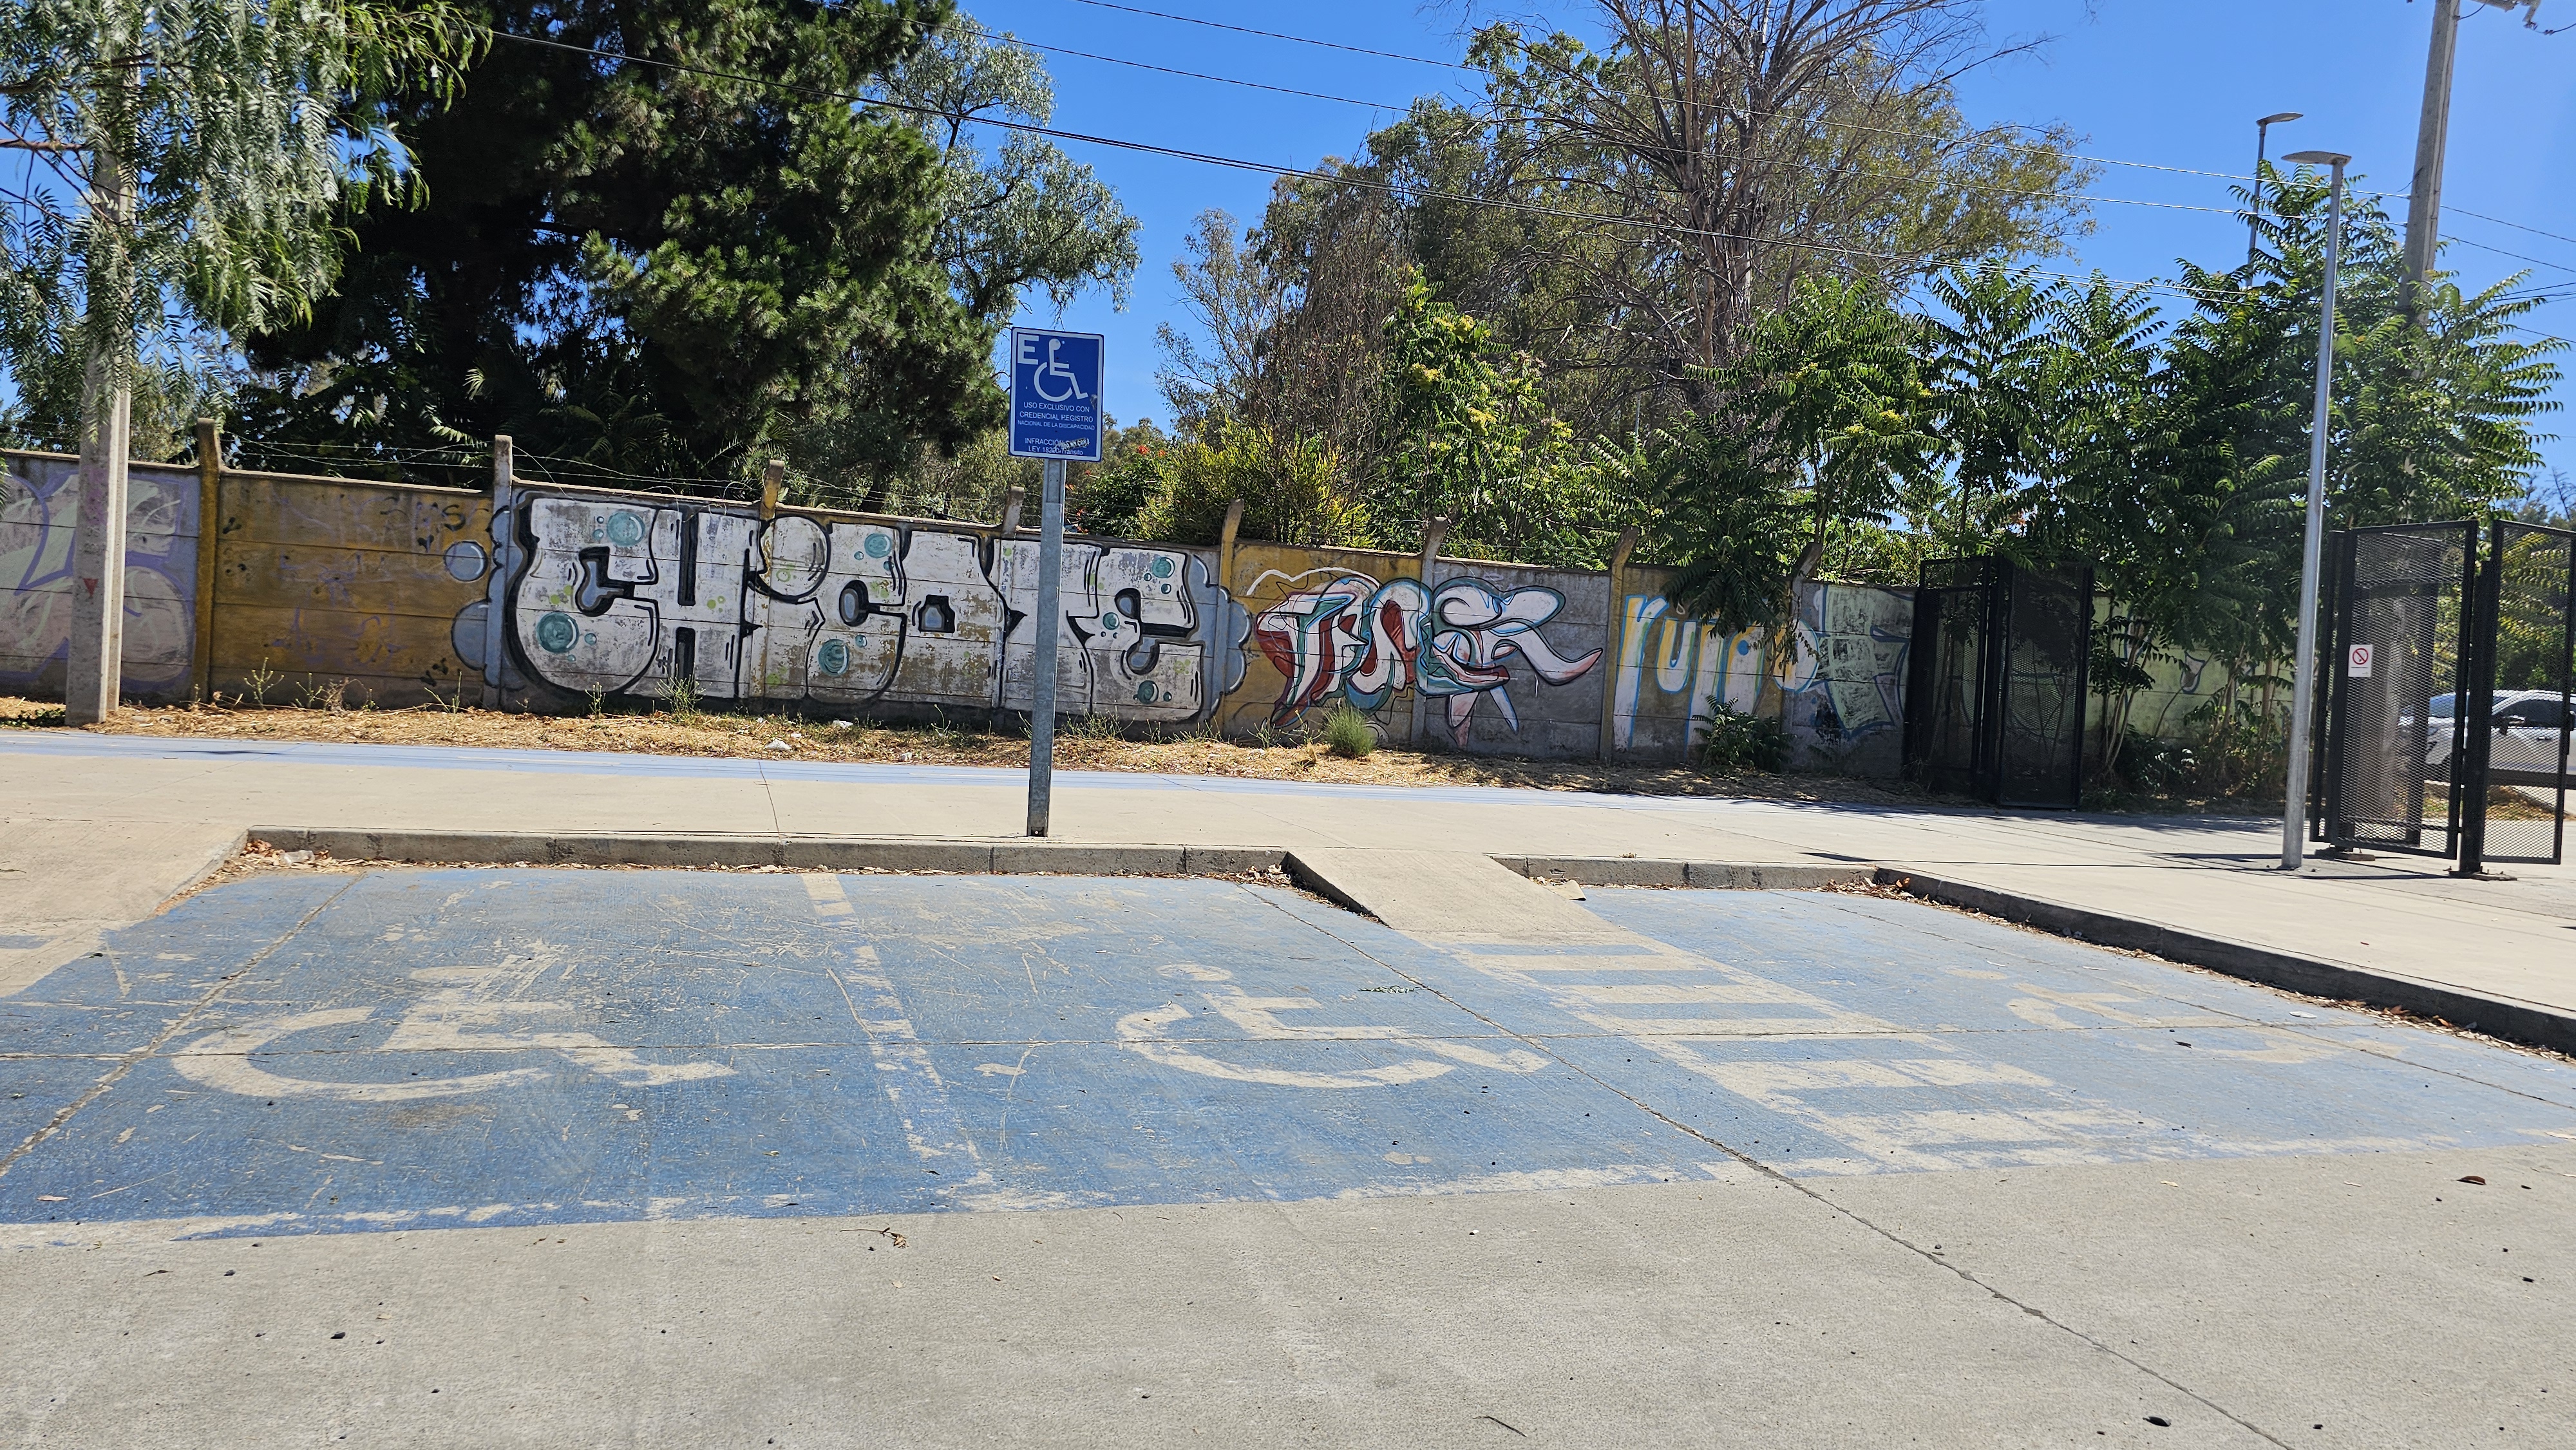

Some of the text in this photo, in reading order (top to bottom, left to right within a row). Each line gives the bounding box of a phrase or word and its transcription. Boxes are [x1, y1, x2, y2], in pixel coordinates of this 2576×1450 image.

[1017, 334, 1039, 365] E
[1039, 402, 1075, 411] EXCLUSIVO
[1019, 411, 1094, 423] CREDENCIAL REGISTRO
[1059, 422, 1095, 431] DISCAPACIDAD
